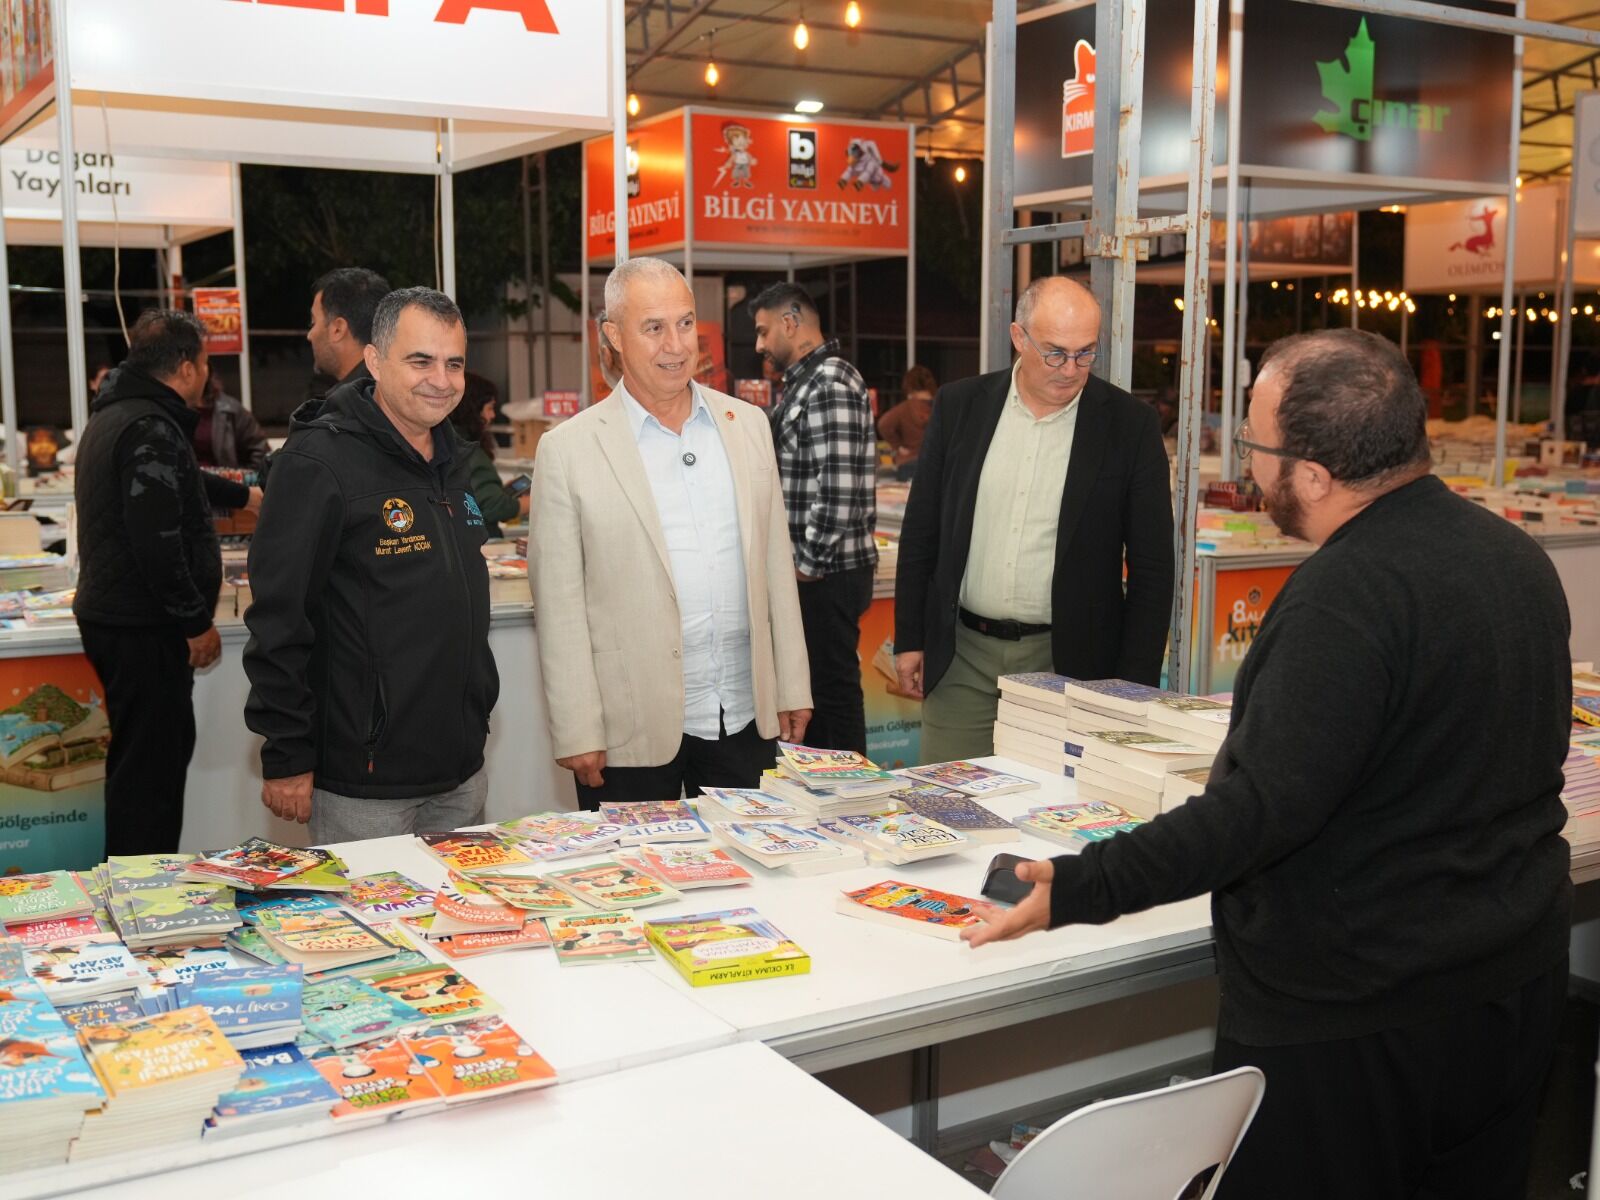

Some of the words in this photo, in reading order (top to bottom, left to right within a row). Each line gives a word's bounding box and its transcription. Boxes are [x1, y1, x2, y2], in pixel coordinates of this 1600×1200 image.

[11, 170, 131, 198] Yaynları
[590, 209, 615, 237] BİLG
[627, 190, 680, 229] AYINEVİ
[703, 190, 775, 221] BİLGİ
[782, 198, 899, 226] YAYINEVİ
[755, 965, 782, 975] OKUMA
